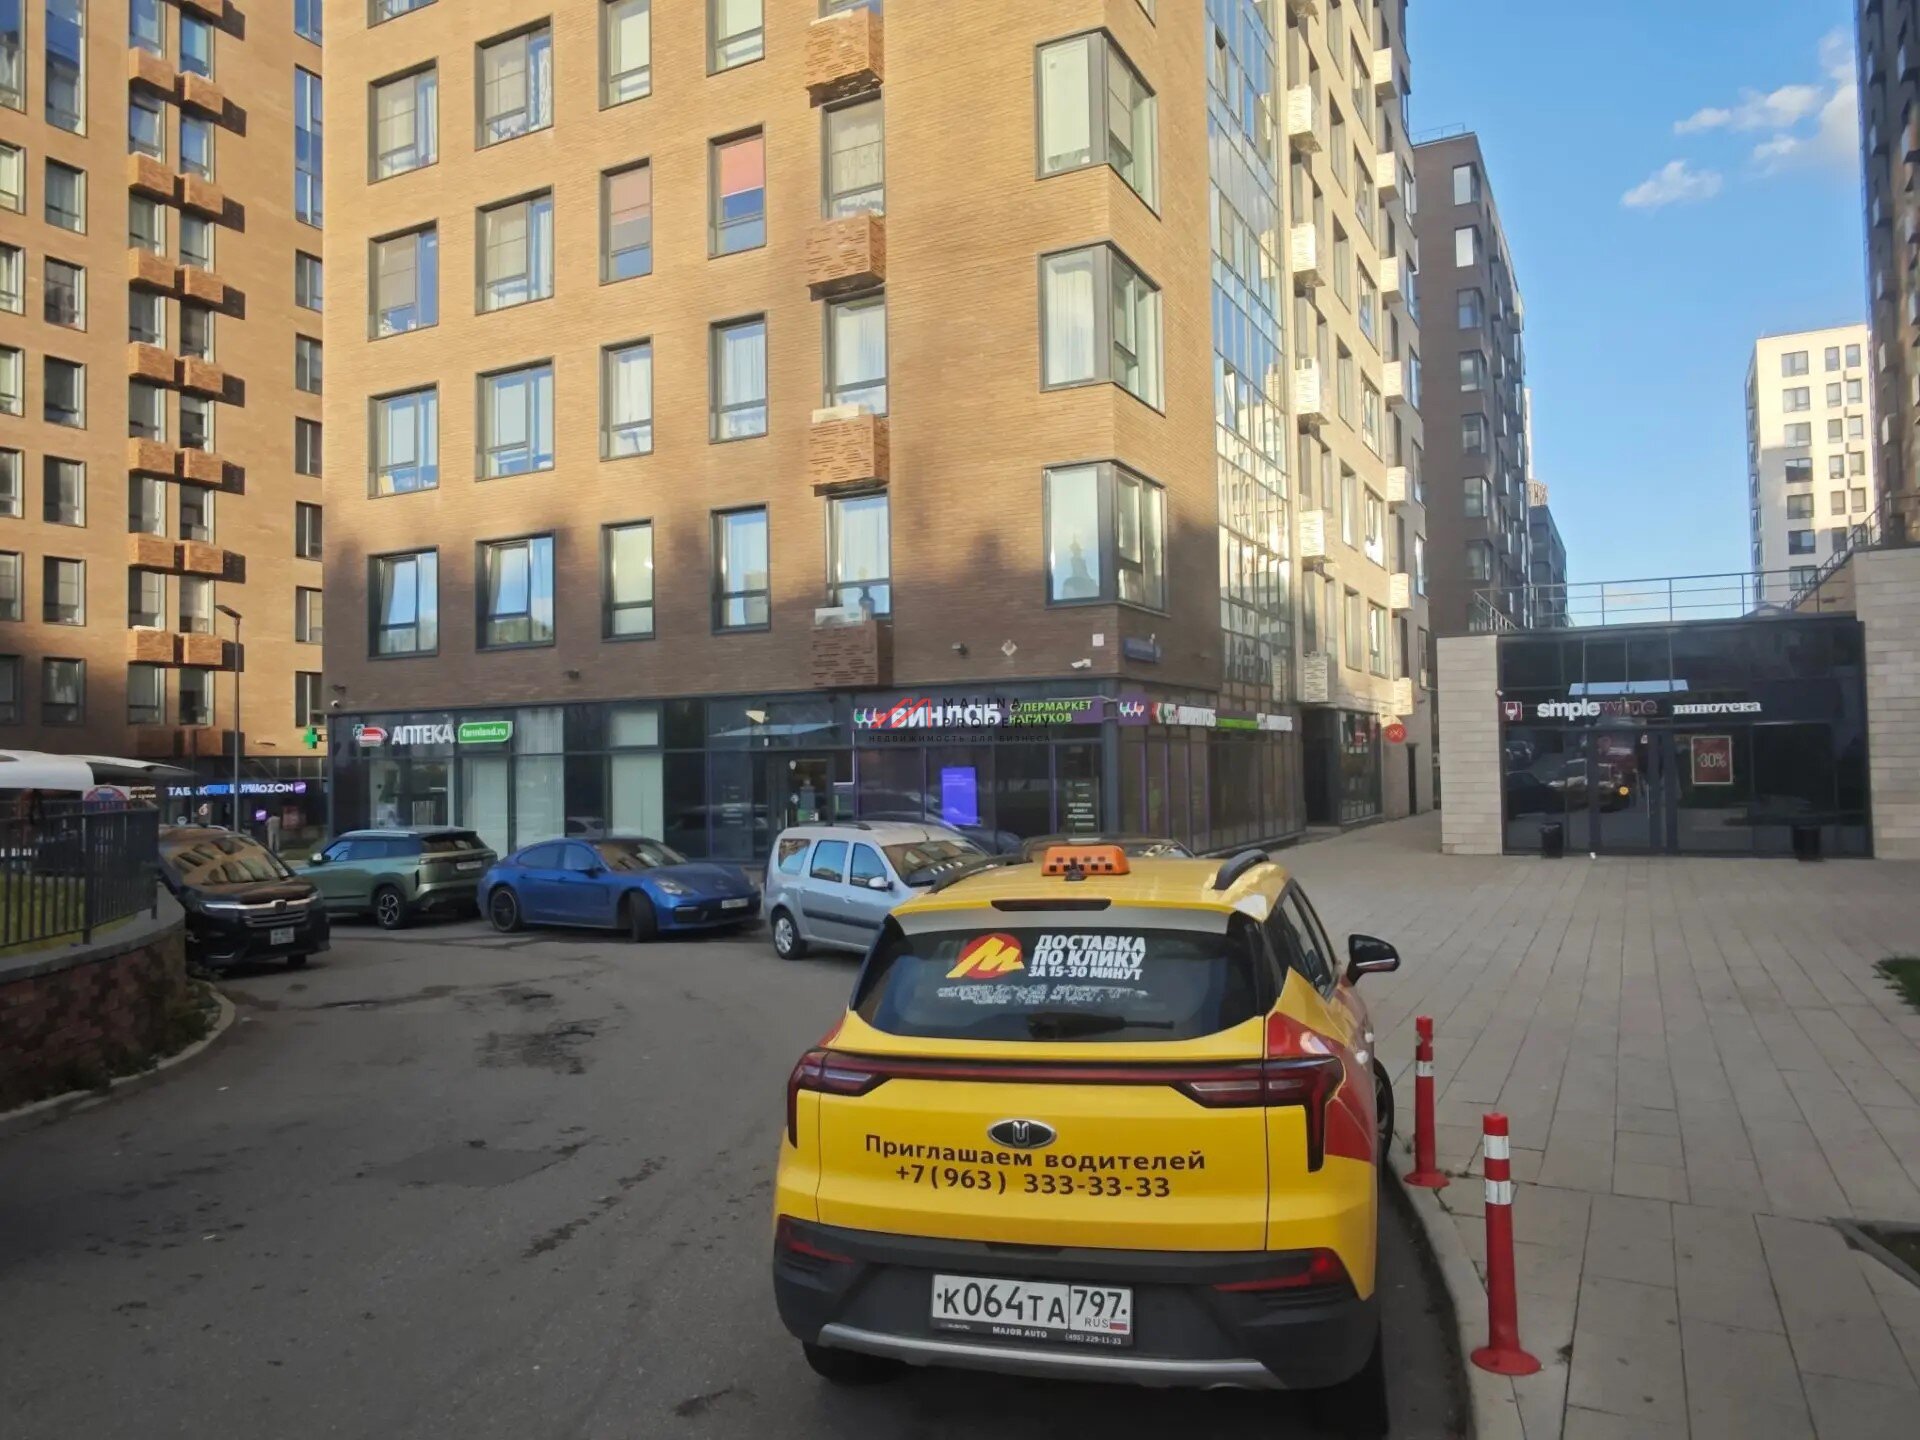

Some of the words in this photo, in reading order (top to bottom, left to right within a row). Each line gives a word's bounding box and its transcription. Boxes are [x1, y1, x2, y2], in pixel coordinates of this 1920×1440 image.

[1009, 700, 1092, 713] СУПЕРМАРКЕТ
[1009, 712, 1073, 724] НАПИТКОВ
[391, 723, 455, 745] АПТЕКА
[167, 785, 207, 796] ТАБК
[1034, 934, 1147, 953] ДОСТАВКА
[1032, 950, 1064, 966] ПО
[1067, 950, 1146, 969] КЛИКУ
[1028, 966, 1046, 978] ЗА
[1049, 966, 1087, 978] 15-30
[1089, 967, 1144, 981] МИНУТ
[864, 1133, 1033, 1167] Приглашаем
[1045, 1149, 1206, 1173] водителей
[1023, 1173, 1171, 1198] 333-33-33
[1072, 1288, 1123, 1318] 797
[1084, 1317, 1109, 1329] RUS
[992, 1325, 1022, 1337] MAJOR
[1024, 1328, 1048, 1339] AUTO
